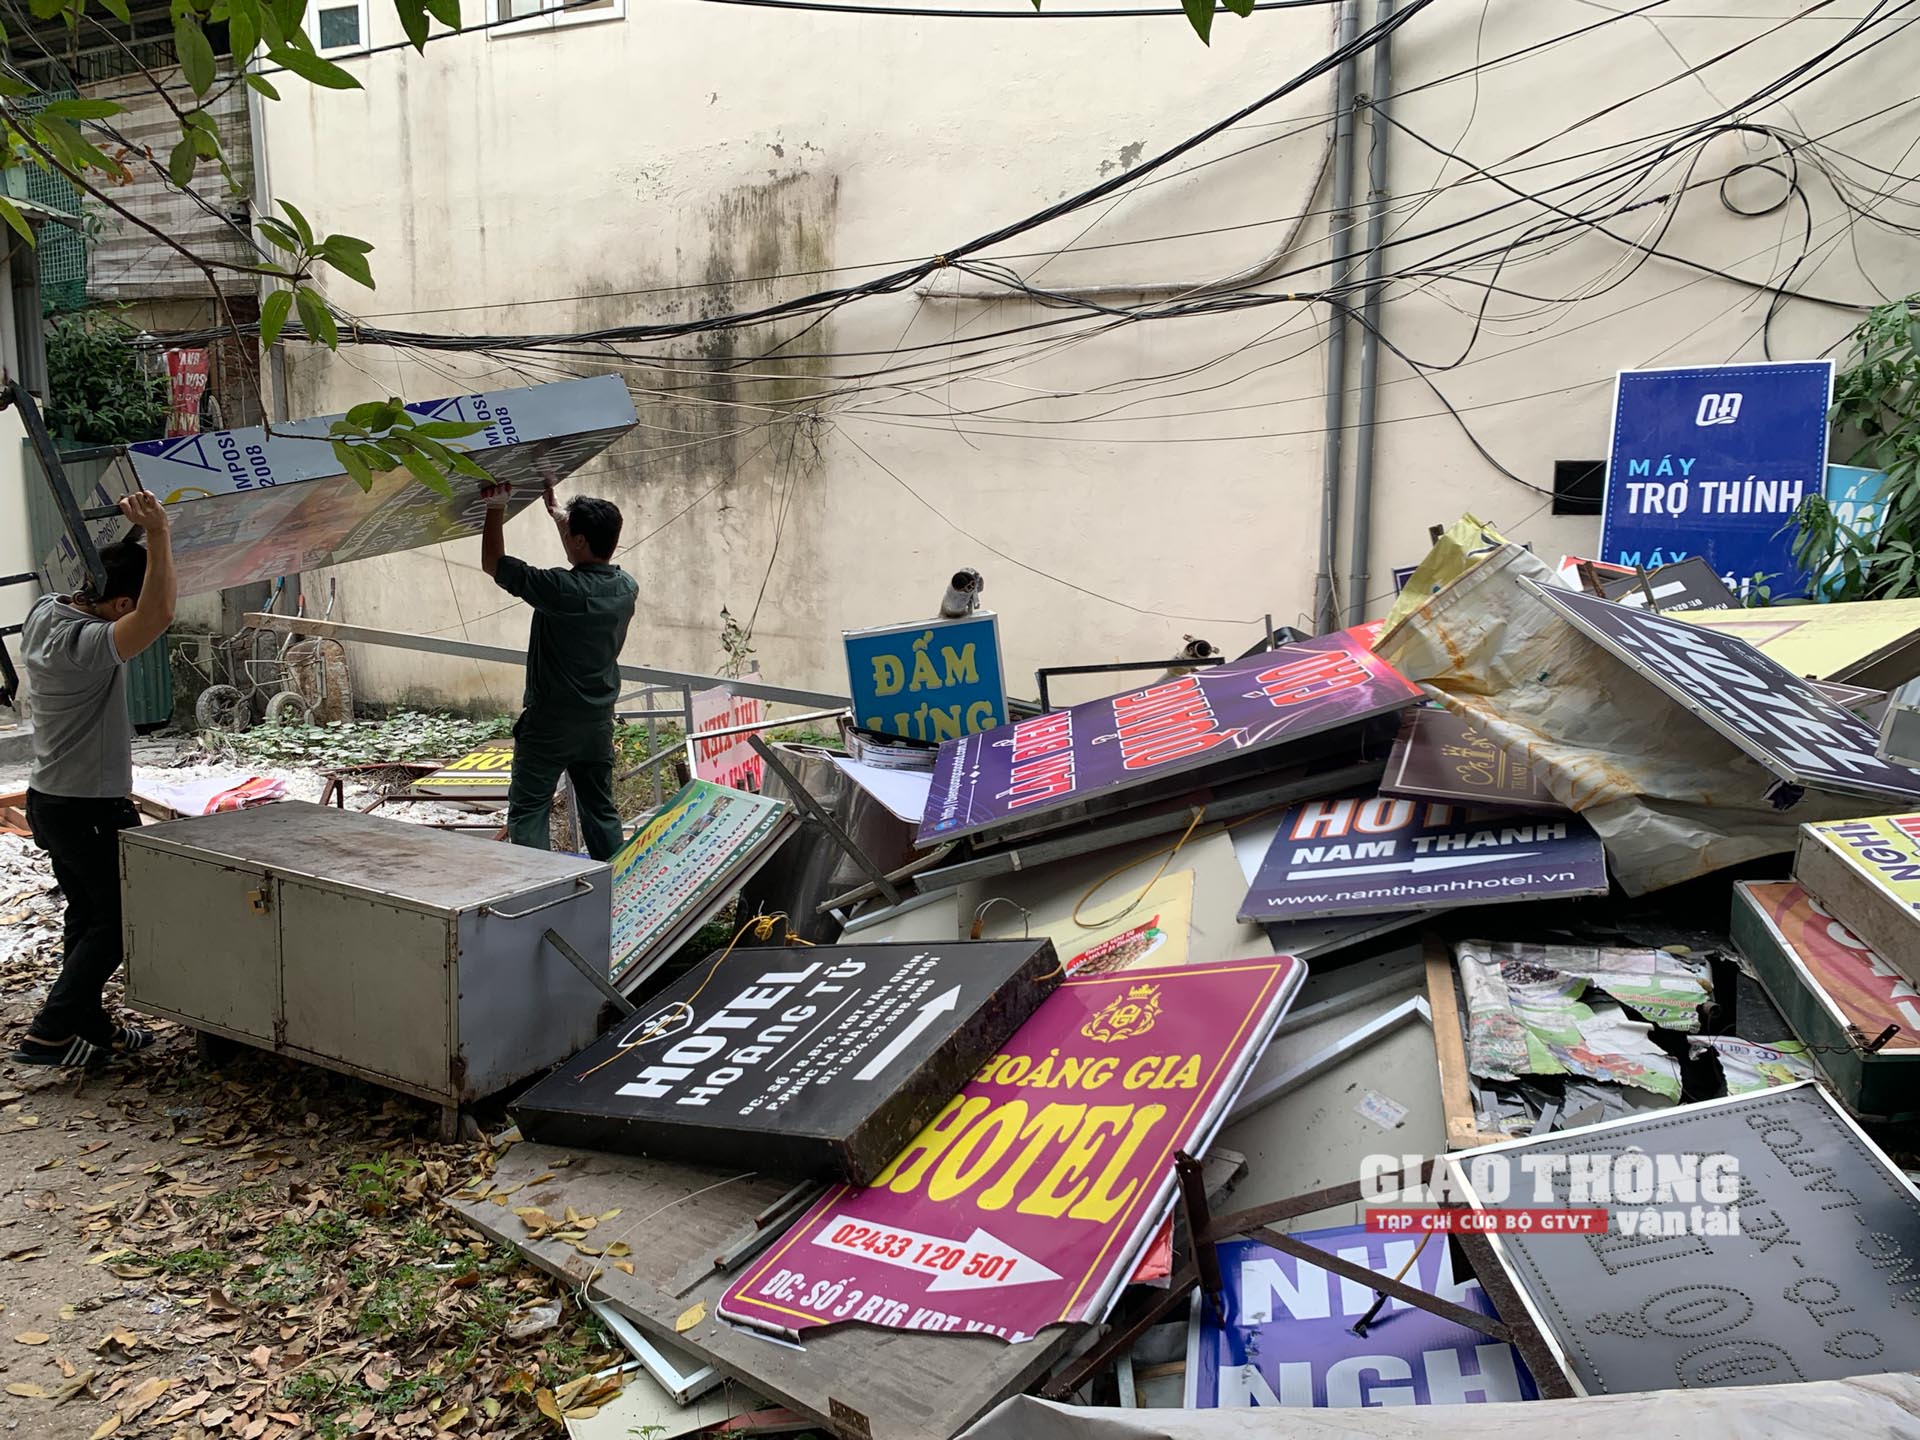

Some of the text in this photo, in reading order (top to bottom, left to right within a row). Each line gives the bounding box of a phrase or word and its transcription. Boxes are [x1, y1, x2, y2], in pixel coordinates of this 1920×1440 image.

[495, 407, 520, 444] 2008
[245, 445, 275, 487] 2008
[1629, 454, 1696, 476] MÁY
[1626, 475, 1803, 518] TRỢ THÍNH
[1620, 548, 1687, 566] MÁY
[871, 630, 979, 696] ĐẤM
[1242, 650, 1374, 707] CÁO
[1632, 616, 1890, 774] HOTEL
[1784, 683, 1847, 720] CAO
[1092, 675, 1247, 770] QUẢNG
[997, 752, 1077, 809] LÀM
[1291, 823, 1567, 865] NAM THANH
[1267, 872, 1576, 906] www.namthanhhotel.vn
[805, 957, 867, 997] TỬ
[615, 962, 824, 1098] HOTEL
[1123, 1054, 1202, 1090] GIA
[868, 1094, 1167, 1224] HOTEL
[1746, 1113, 1862, 1210] LAPTOP
[831, 1224, 1018, 1282] 02433 120 501
[799, 1276, 857, 1311] SỐ
[832, 1289, 864, 1317] 3
[853, 1294, 910, 1328] BT6
